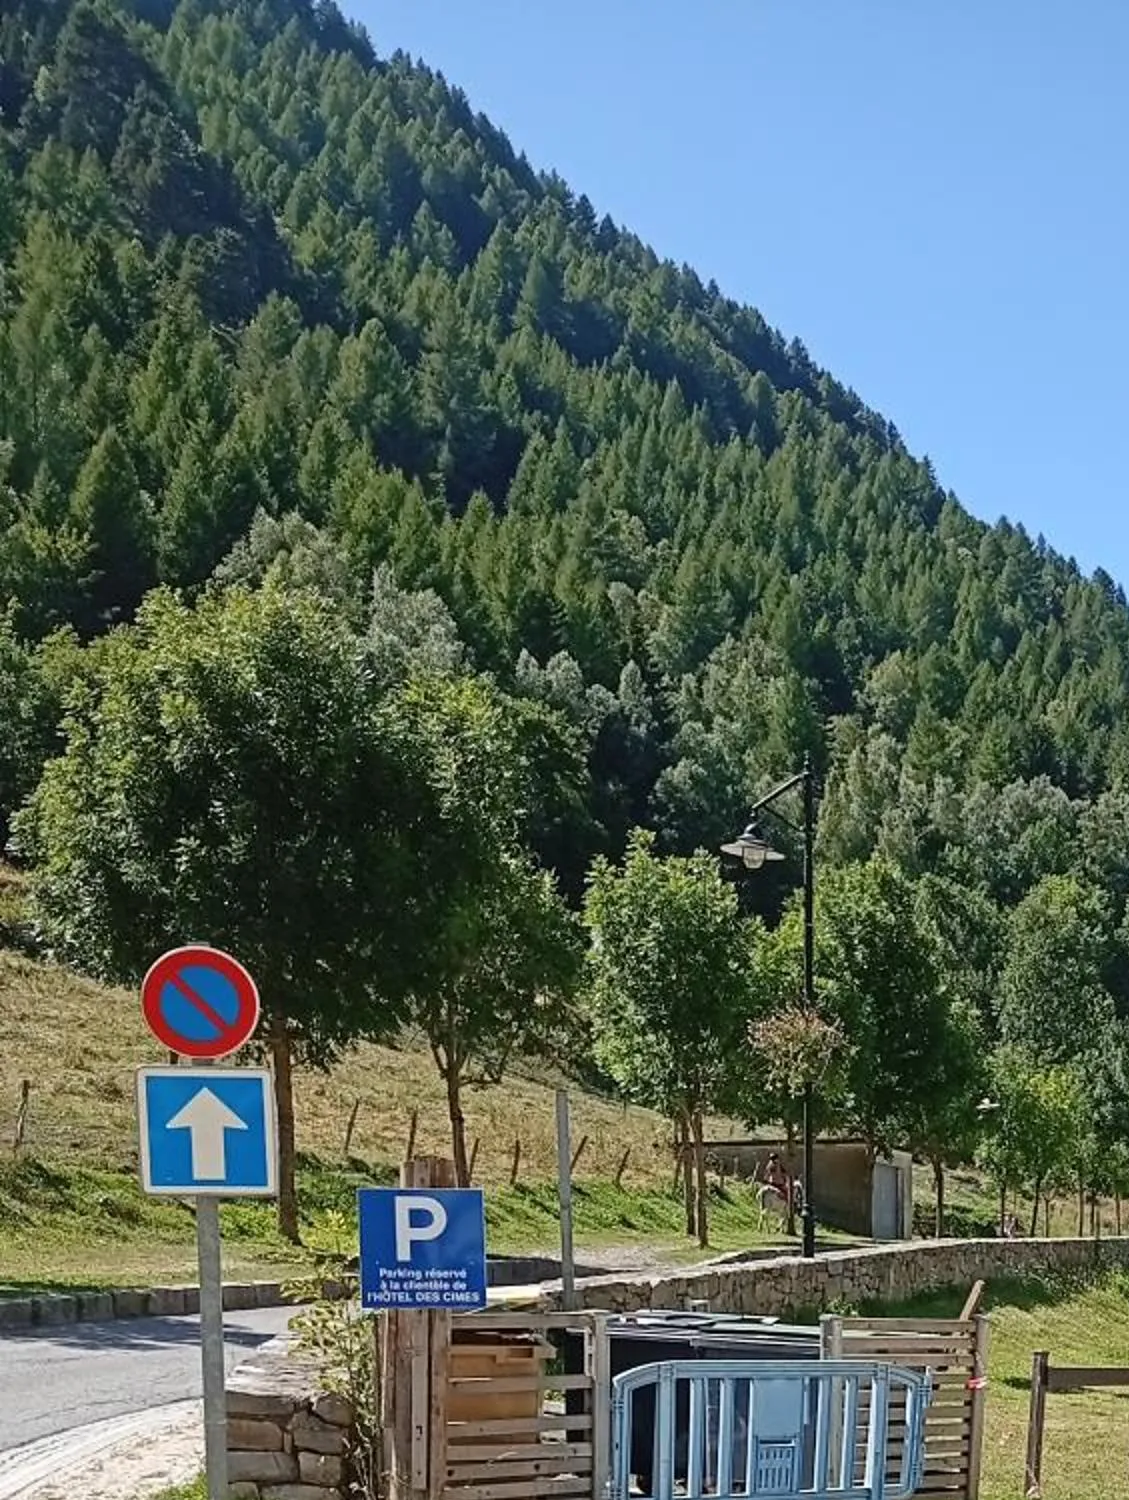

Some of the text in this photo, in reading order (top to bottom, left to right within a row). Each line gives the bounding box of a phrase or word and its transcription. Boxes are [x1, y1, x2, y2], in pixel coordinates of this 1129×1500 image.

[395, 1196, 448, 1262] P
[379, 1268, 467, 1280] Parking réservé
[380, 1280, 467, 1290] à la clientèle de
[415, 1292, 440, 1302] DES
[443, 1292, 480, 1302] CIMES
